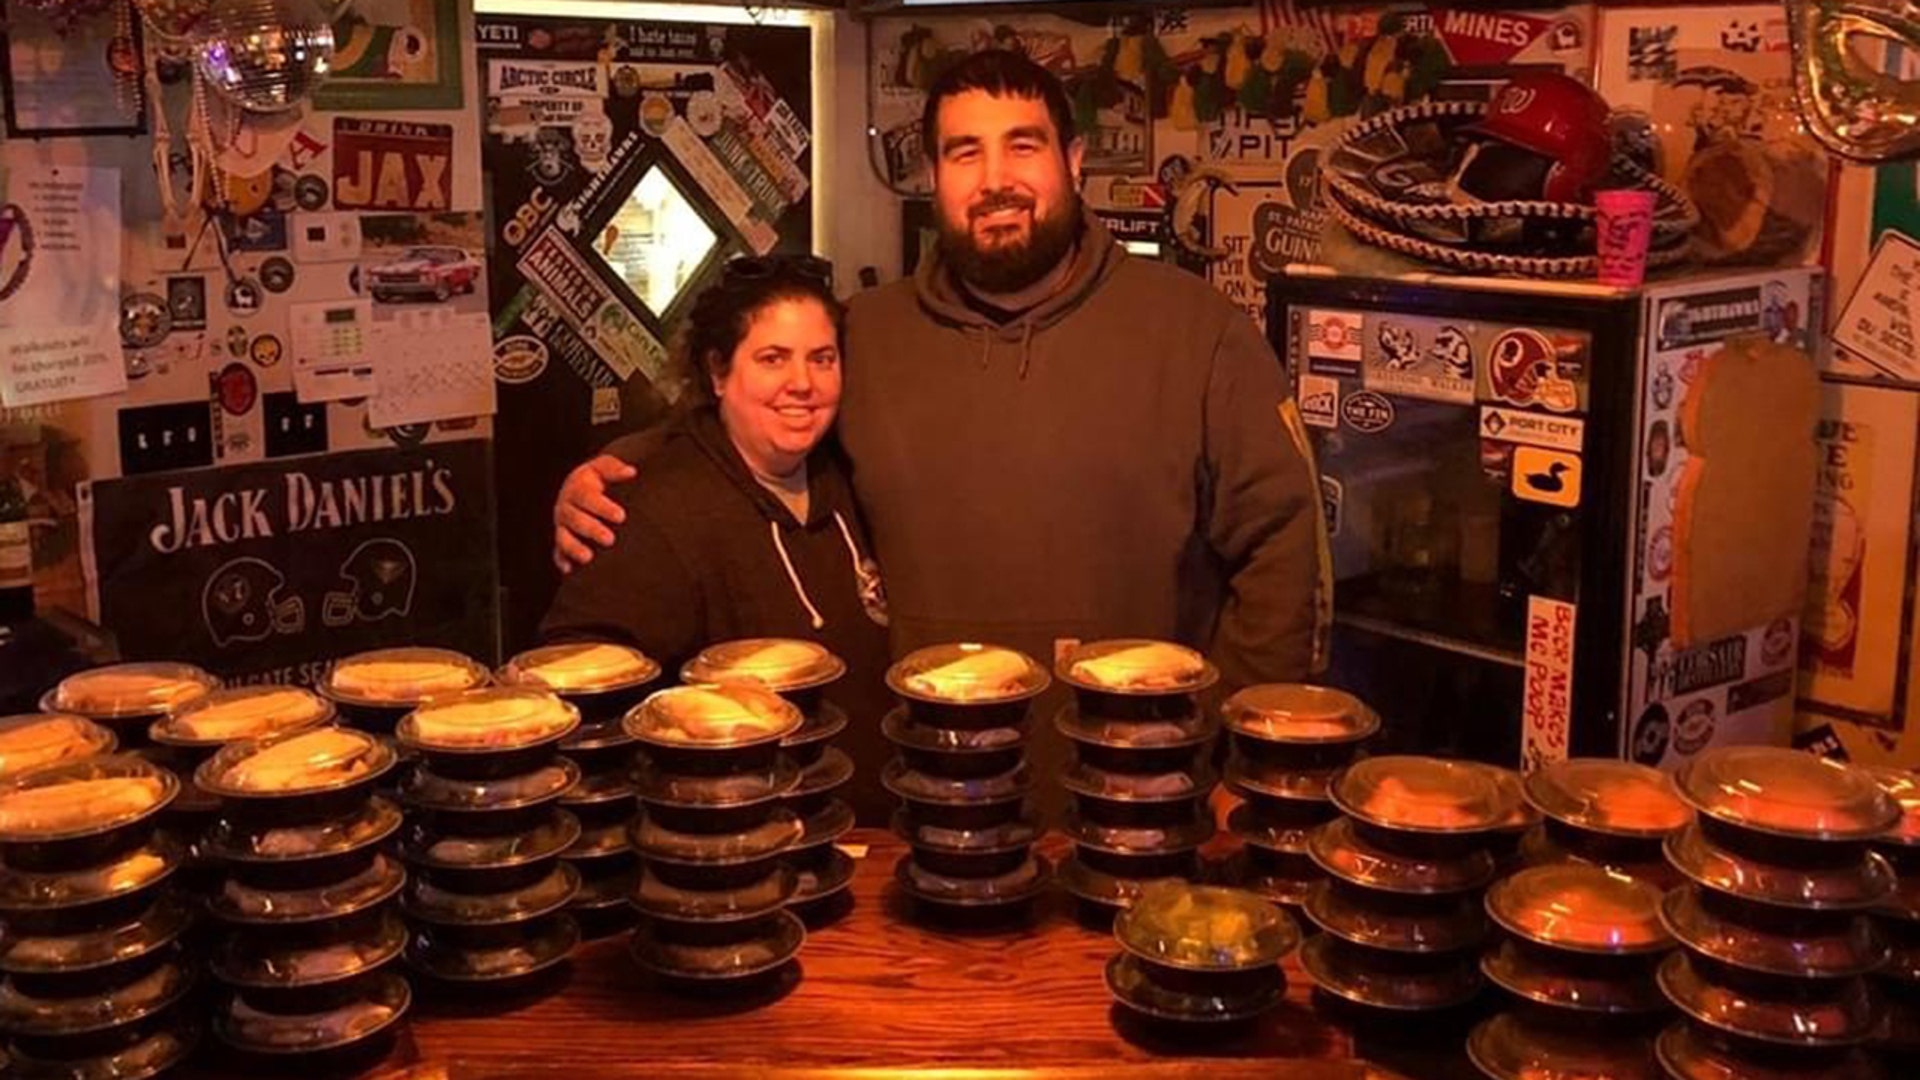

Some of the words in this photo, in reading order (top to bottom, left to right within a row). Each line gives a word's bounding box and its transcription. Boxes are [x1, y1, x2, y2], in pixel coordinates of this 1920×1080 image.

[479, 24, 519, 41] YETI
[1444, 9, 1530, 47] MINES
[500, 65, 549, 90] ARCTIC
[551, 66, 598, 91] CIRCLE
[1239, 134, 1295, 159] PIT
[336, 150, 449, 209] JAX
[503, 186, 554, 247] OBC
[527, 248, 594, 319] ANIMALS
[1508, 415, 1545, 432] PORT
[1547, 420, 1579, 437] CITY
[149, 485, 274, 555] JACK
[284, 458, 457, 533] DANIEL'S
